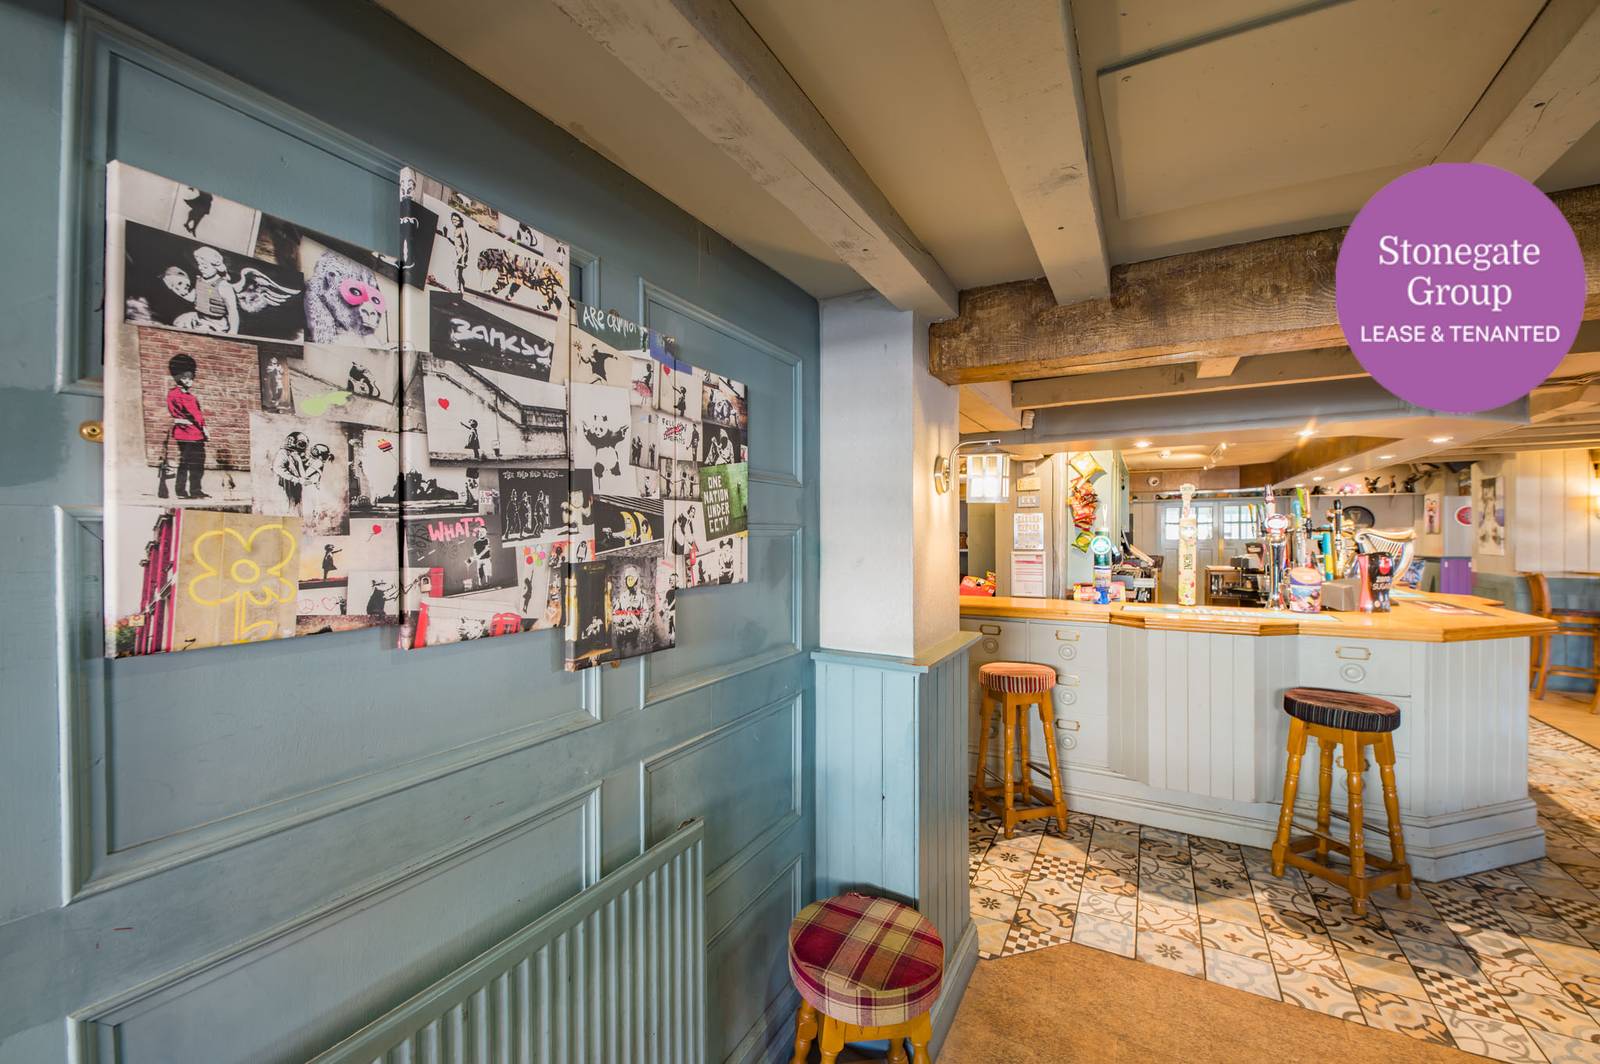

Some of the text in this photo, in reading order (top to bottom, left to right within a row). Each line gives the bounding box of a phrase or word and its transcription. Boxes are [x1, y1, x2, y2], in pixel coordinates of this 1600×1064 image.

[707, 475, 722, 489] ONE
[703, 488, 729, 505] NATION
[707, 502, 730, 518] UNDER
[427, 516, 486, 542] WHAT?
[709, 515, 730, 533] CCTV
